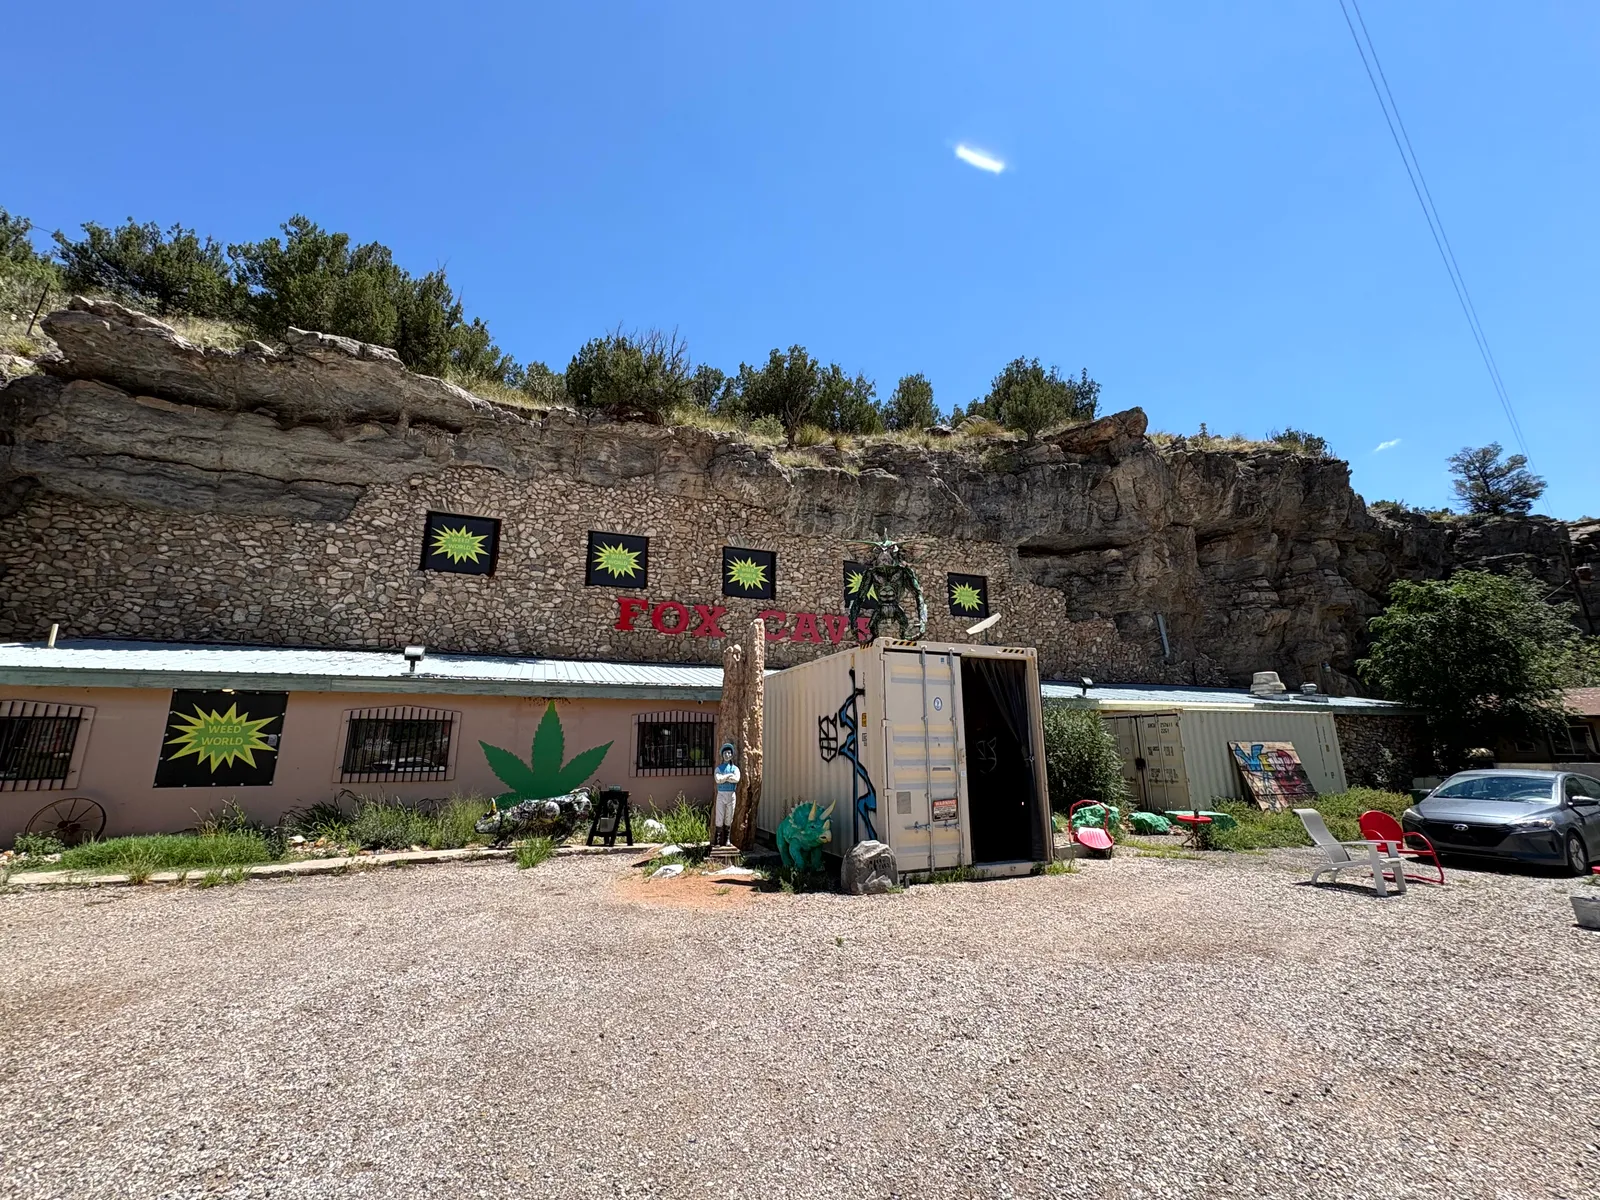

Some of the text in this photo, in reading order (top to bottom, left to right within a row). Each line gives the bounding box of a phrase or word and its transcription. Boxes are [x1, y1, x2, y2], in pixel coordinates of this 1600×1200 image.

[614, 596, 727, 638] FOX
[208, 725, 242, 734] WEED
[201, 736, 244, 746] WORLD
